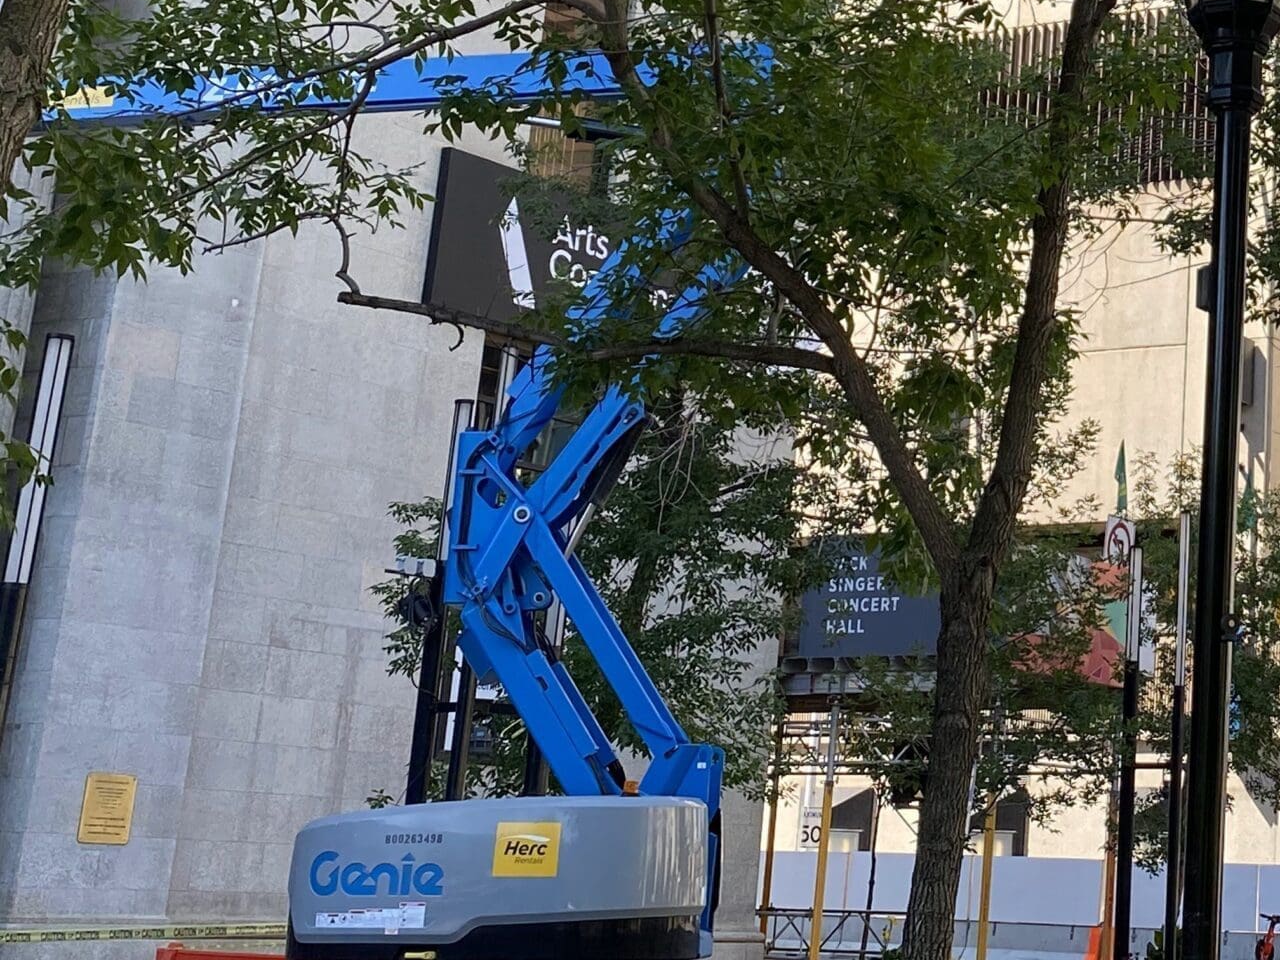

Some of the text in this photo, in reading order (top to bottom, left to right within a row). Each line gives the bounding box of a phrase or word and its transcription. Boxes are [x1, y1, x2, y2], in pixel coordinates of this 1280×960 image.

[552, 214, 609, 259] Arts
[826, 619, 865, 634] HALL
[801, 825, 822, 843] 50
[504, 841, 548, 856] Herc
[514, 856, 543, 865] Rentals
[310, 850, 445, 897] Genie
